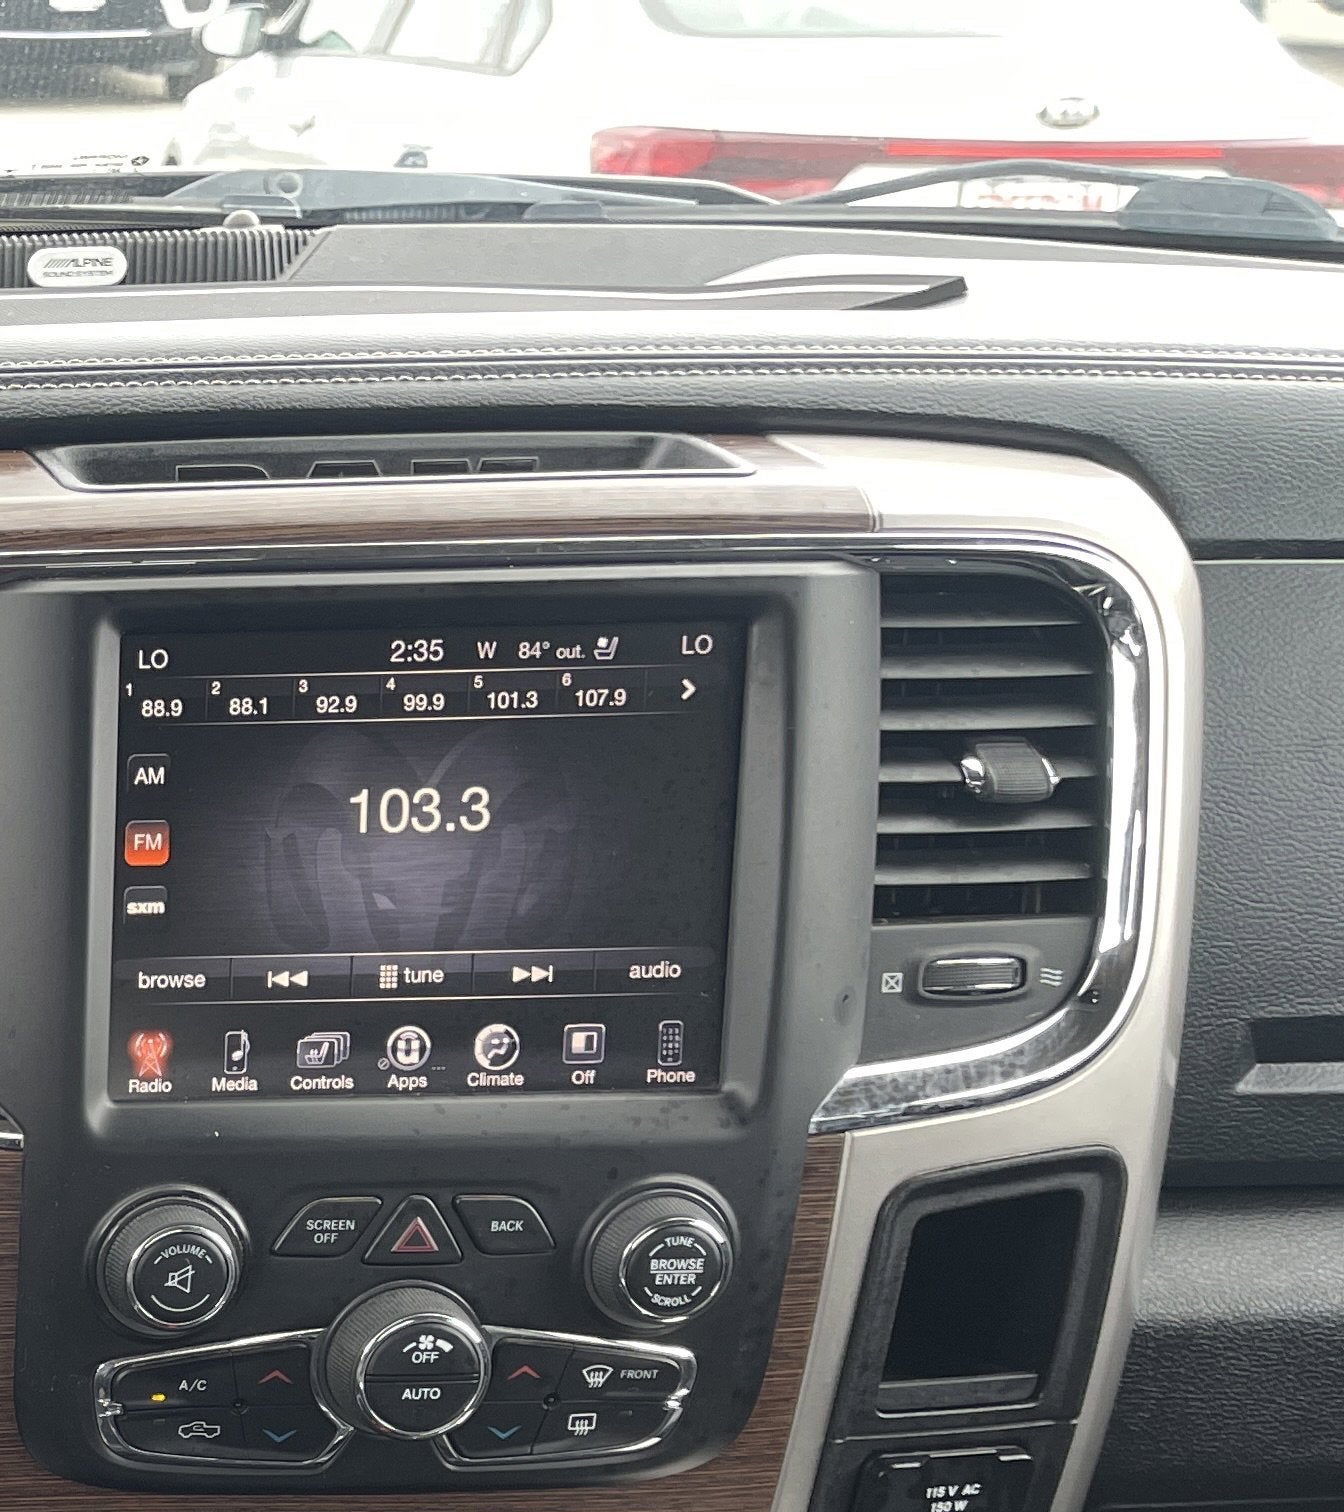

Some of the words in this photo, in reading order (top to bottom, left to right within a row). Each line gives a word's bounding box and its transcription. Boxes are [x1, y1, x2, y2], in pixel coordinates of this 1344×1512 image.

[389, 639, 444, 663] 2:35
[476, 640, 497, 660] W
[518, 640, 551, 659] 84°
[555, 644, 586, 660] out.
[681, 634, 713, 655] LO
[138, 648, 169, 670] LO
[210, 680, 221, 695] 2
[298, 679, 309, 693] 3
[385, 676, 396, 691] 4
[473, 674, 484, 689] 5
[561, 672, 572, 687] 6
[125, 682, 133, 697] 1
[574, 688, 627, 707] 107.9
[141, 698, 183, 718] 88.9
[229, 697, 268, 716] 88.1
[315, 695, 358, 714] 92.9
[403, 693, 445, 712] 99.9
[486, 690, 539, 710] 101.3
[133, 766, 165, 785] AM
[349, 786, 491, 834] 103.3
[133, 833, 162, 851] FM
[126, 901, 166, 915] sxm
[403, 966, 445, 984] tune
[628, 960, 682, 979] audio
[138, 970, 206, 989] browse
[211, 1076, 259, 1092] Media
[290, 1074, 355, 1091] Controls
[387, 1073, 428, 1091] Apps
[466, 1071, 525, 1087] Climate
[571, 1069, 597, 1085] Off
[646, 1068, 696, 1084] Phone
[128, 1076, 173, 1094] Radio
[306, 1219, 356, 1231] SCREEN
[490, 1220, 524, 1232] BACK
[313, 1232, 339, 1244] OFF
[665, 1236, 694, 1248] TUNE
[160, 1245, 205, 1259] VOLUME
[650, 1258, 704, 1272] BROWSE
[656, 1273, 697, 1285] ENTER
[650, 1292, 692, 1307] SCROLL
[411, 1351, 440, 1364] OFF
[620, 1369, 659, 1380] FRONT
[178, 1378, 207, 1392] A/C
[401, 1387, 441, 1400] AUTO
[961, 1483, 981, 1495] AC
[954, 1500, 968, 1511] W
